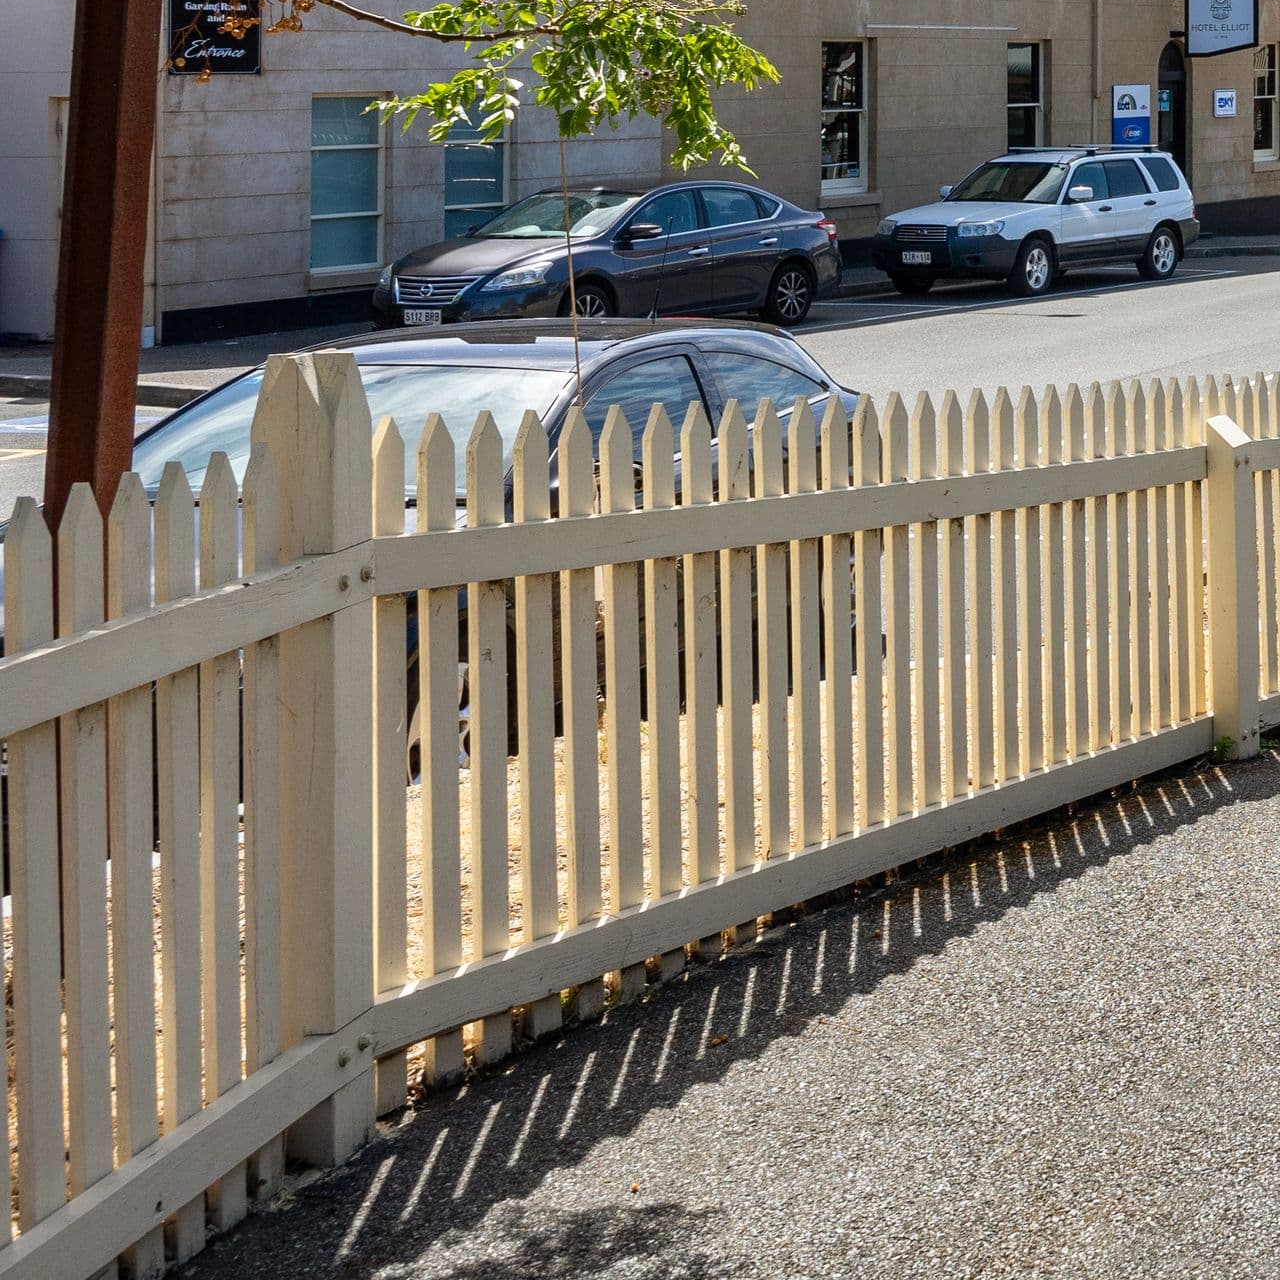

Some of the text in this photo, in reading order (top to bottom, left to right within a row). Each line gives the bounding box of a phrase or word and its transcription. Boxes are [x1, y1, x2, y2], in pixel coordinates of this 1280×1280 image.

[1191, 23, 1250, 32] HOTEL ELLIOT
[184, 39, 246, 58] Entrance
[1218, 96, 1234, 108] SKY
[405, 312, 423, 321] S112
